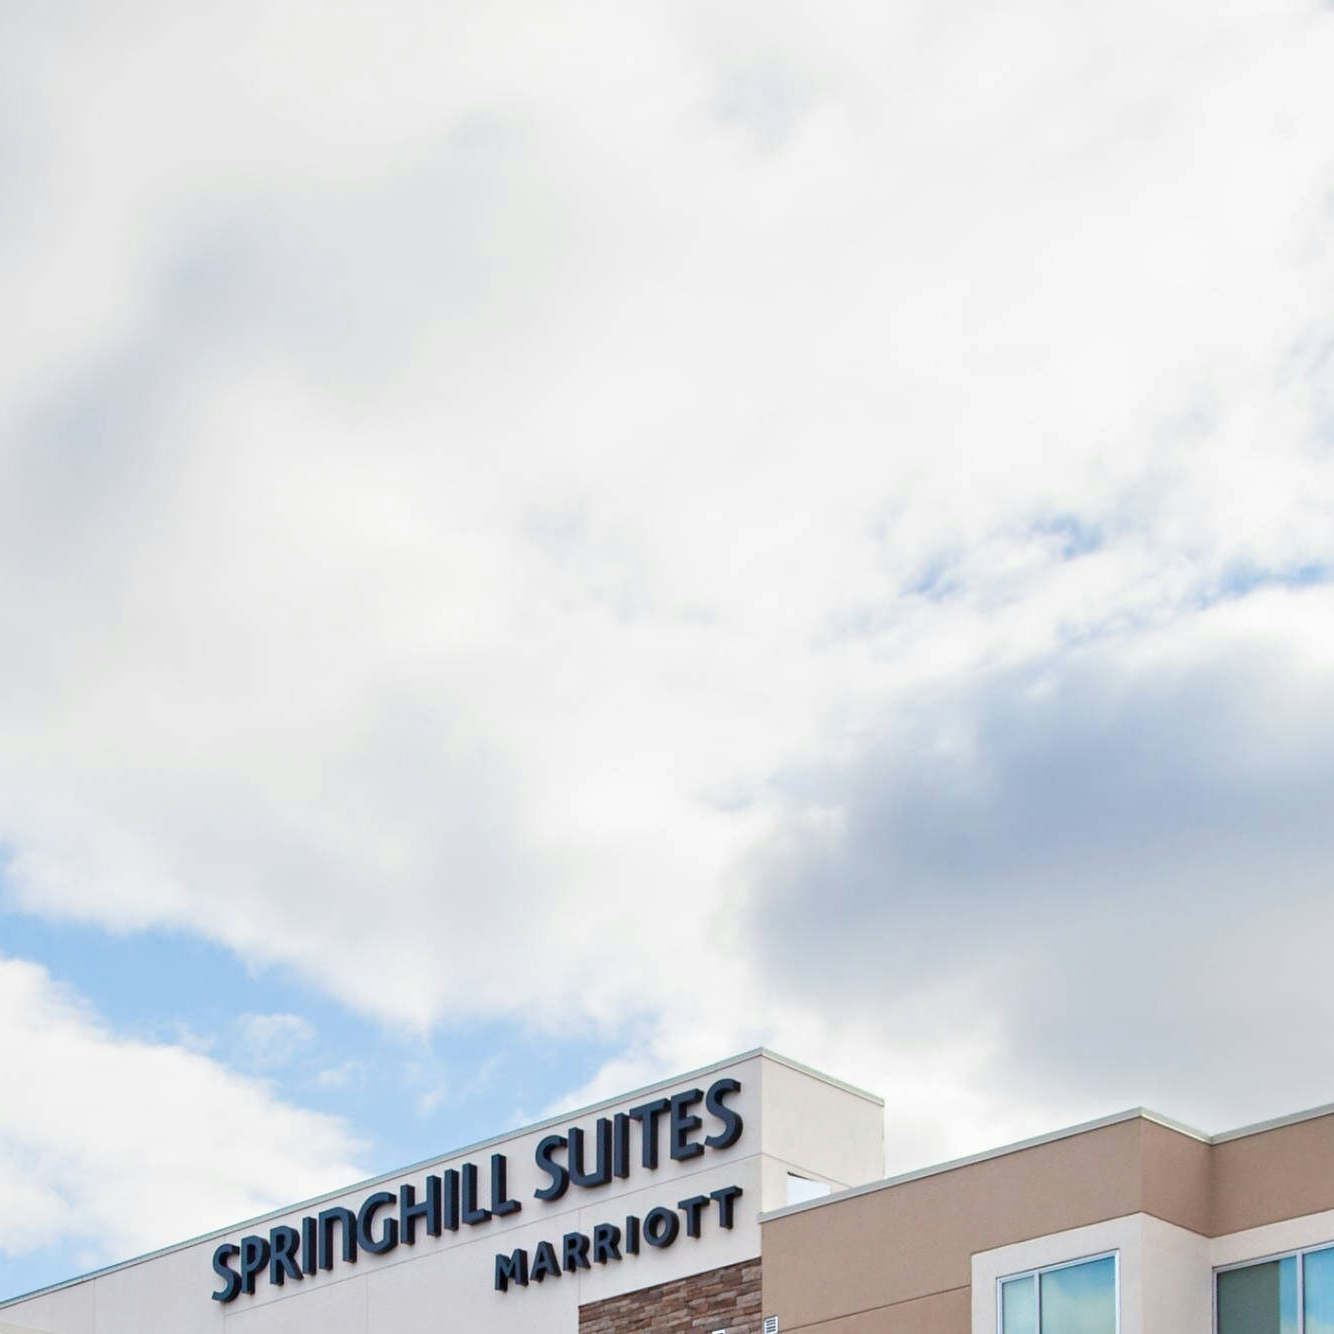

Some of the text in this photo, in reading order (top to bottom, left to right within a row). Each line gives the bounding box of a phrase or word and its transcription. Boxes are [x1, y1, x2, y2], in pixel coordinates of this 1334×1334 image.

[212, 1078, 741, 1301] SPRINGHILL SUITES
[494, 1185, 744, 1292] MARRIOTT
